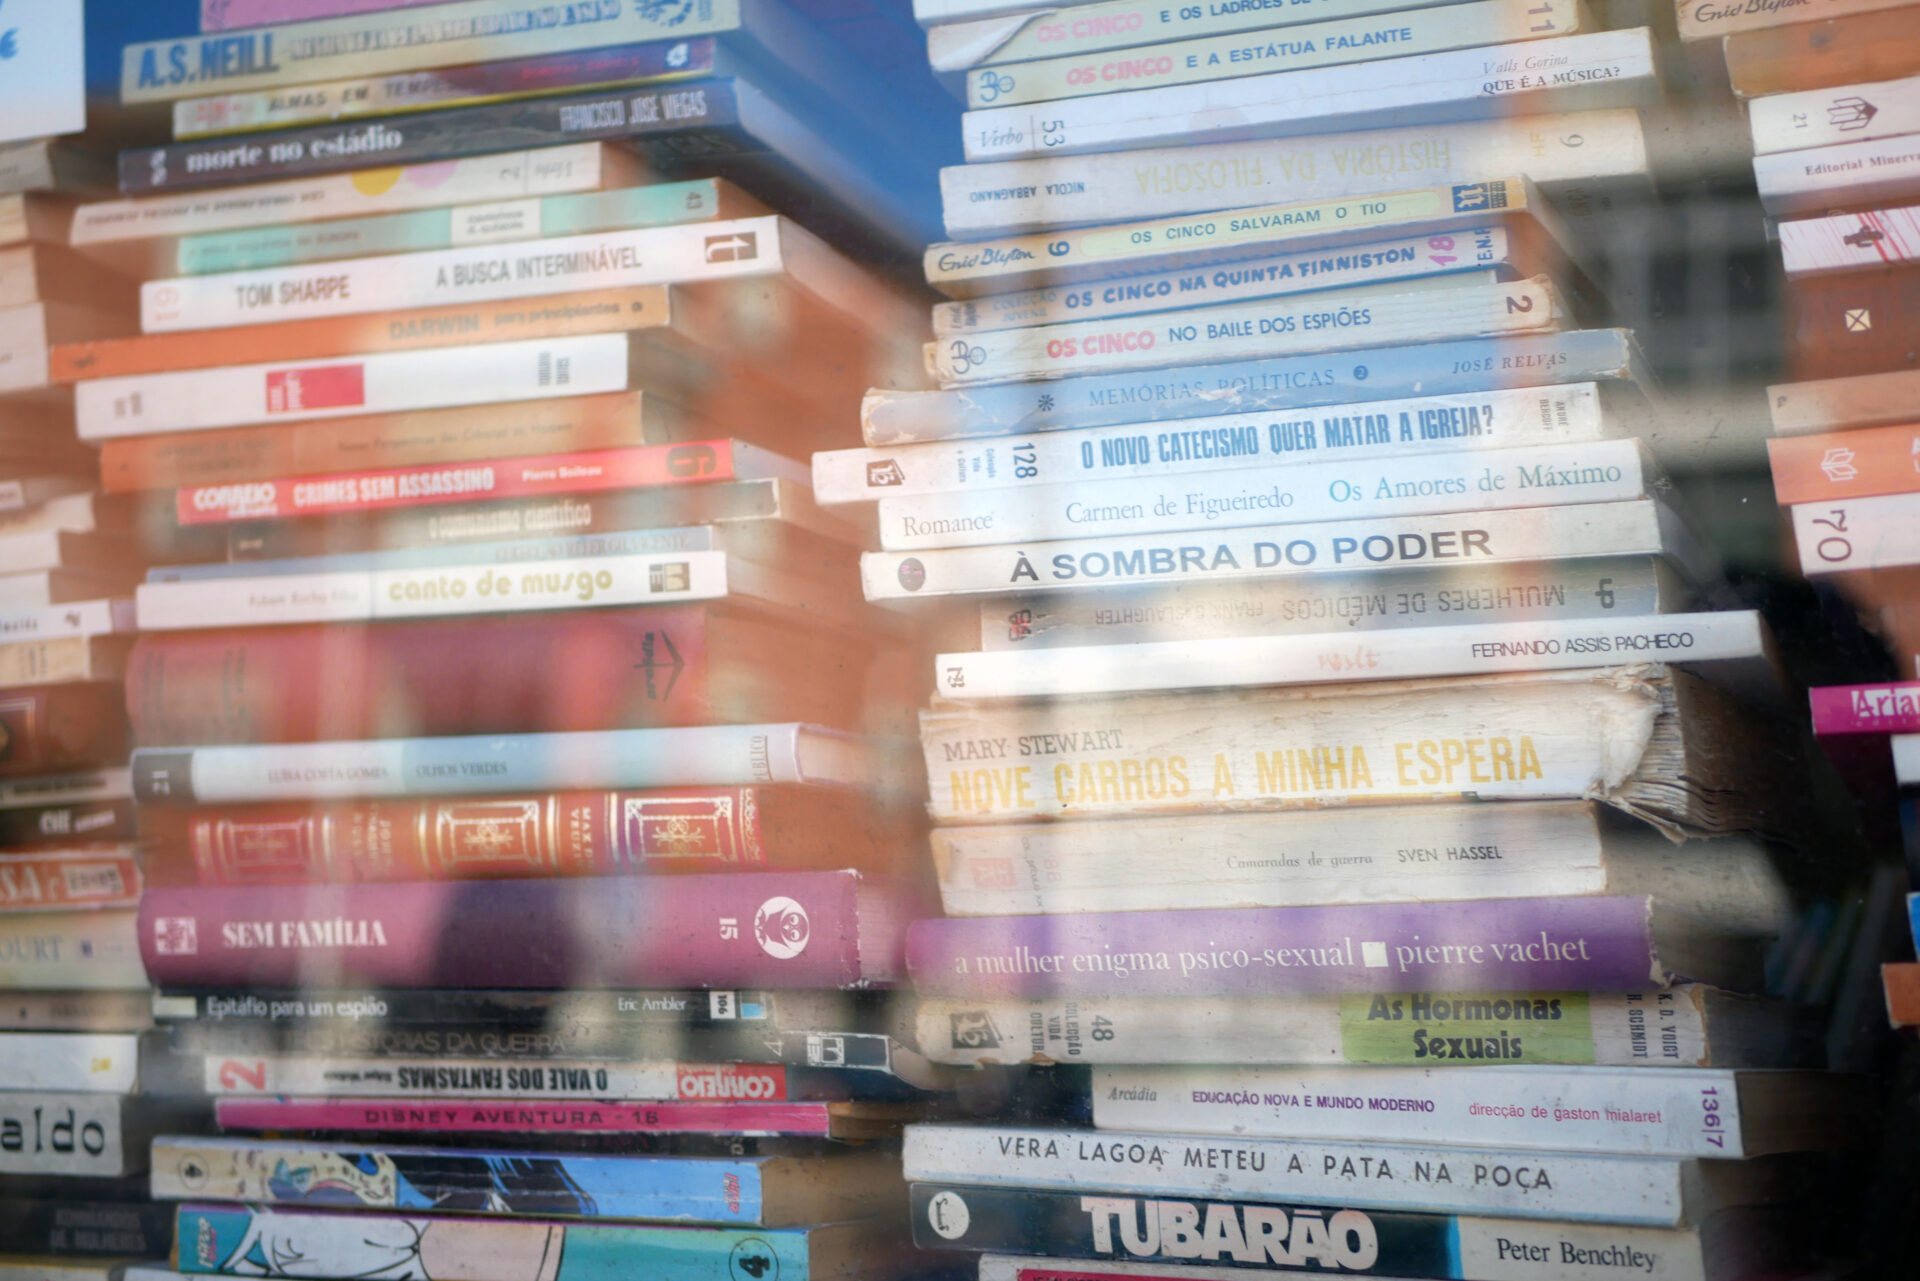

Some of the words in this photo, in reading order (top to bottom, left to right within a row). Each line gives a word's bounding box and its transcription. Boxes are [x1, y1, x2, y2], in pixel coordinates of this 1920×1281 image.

[1037, 24, 1067, 42] OS
[1071, 12, 1145, 40] CINCO
[1160, 10, 1171, 24] E
[1180, 5, 1202, 21] OS
[1694, 3, 1743, 22] Enid
[1066, 66, 1097, 86] OS
[1101, 55, 1173, 82] CINCO
[1186, 56, 1198, 69] E
[1207, 52, 1220, 66] A
[1229, 36, 1317, 63] ESTÁTUA
[1325, 27, 1413, 50] FALANTE
[1482, 58, 1518, 75] Valls
[1523, 53, 1569, 70] Gorina
[1482, 79, 1515, 96] QUE
[1520, 73, 1532, 89] É
[1535, 74, 1548, 87] A
[1552, 65, 1622, 85] MÚSICA?
[980, 127, 1025, 149] Verbo
[1042, 119, 1066, 148] 53
[186, 142, 263, 172] morte
[270, 140, 303, 162] no
[310, 124, 403, 158] estádio
[1331, 139, 1451, 177] HISTÓRIA
[1134, 158, 1263, 195] FILOSOFIA
[1280, 154, 1316, 182] DA
[1805, 158, 1864, 177] Editorial
[970, 186, 1037, 203] ABBAGNANO
[1047, 182, 1085, 197] NICOLA
[1131, 231, 1152, 245] OS
[1166, 224, 1217, 240] CINCO
[1230, 210, 1321, 232] SALVARAM
[1336, 207, 1348, 219] O
[1361, 202, 1387, 216] TIO
[436, 267, 447, 288] A
[454, 258, 511, 285] BUSCA
[516, 243, 642, 280] INTERMINÁVEL
[938, 249, 979, 271] Enid
[980, 246, 1036, 271] Blyton
[236, 284, 273, 309] TOM
[280, 275, 352, 304] SHARPE
[1065, 291, 1094, 309] OS
[1103, 281, 1172, 304] CINCO
[1179, 277, 1207, 291] NA
[1213, 263, 1295, 289] QUINTA
[1299, 247, 1416, 277] FINNISTON
[1506, 295, 1533, 313] 2
[389, 314, 479, 340] DARWIN
[1047, 339, 1078, 359] OS
[1082, 330, 1156, 355] CINCO
[1169, 326, 1198, 343] NO
[1206, 322, 1253, 341] BAILE
[1260, 317, 1295, 335] DOS
[1303, 307, 1371, 331] ESPIÕES
[1452, 356, 1493, 375] JOSÉ
[1218, 368, 1335, 395] POLÍTICAS
[1082, 440, 1093, 469] O
[1101, 435, 1151, 468] NOVO
[1158, 425, 1259, 464] CATECISMO
[1269, 421, 1317, 453] QUER
[1324, 414, 1391, 447] MATAR
[1400, 411, 1413, 441] A
[1419, 404, 1494, 441] IGREJA?
[1012, 441, 1038, 480] 128
[293, 478, 357, 508] CRIMES
[359, 473, 395, 501] SEM
[399, 465, 494, 498] ASSASSINO
[1065, 498, 1144, 525] Carmen
[1153, 493, 1178, 518] de
[1185, 486, 1295, 521] Figueiredo
[1329, 479, 1363, 503] Os
[1374, 475, 1467, 500] Amores
[1479, 468, 1505, 492] de
[1516, 464, 1623, 490] Máximo
[903, 514, 994, 538] Romance
[1812, 509, 1852, 562] 70
[1009, 550, 1040, 583] À
[1052, 543, 1239, 580] SOMBRA
[1254, 539, 1317, 568] DO
[1333, 528, 1494, 563] PODER
[389, 571, 468, 601] canto
[476, 570, 513, 597] de
[1437, 584, 1565, 612] MULHERES
[1095, 607, 1185, 625] SLAUGHTER
[1398, 591, 1426, 613] DE
[1471, 639, 1561, 658] FERNANDO
[1565, 636, 1612, 654] ASSIS
[1615, 631, 1694, 651] PACHECO
[944, 739, 1007, 763] MARY
[1018, 728, 1124, 756] STEWART
[951, 766, 1036, 811] NOVE
[1054, 756, 1191, 807] CARROS
[1213, 753, 1234, 796] A
[1255, 745, 1373, 793] MINHA
[1395, 736, 1543, 787] ESPERA
[1226, 854, 1300, 869] Camaradas
[1307, 854, 1324, 867] de
[1397, 847, 1439, 864] SVEN
[1447, 845, 1503, 861] HASSEL
[223, 921, 275, 950] SEM
[281, 916, 387, 948] FAMÍLIA
[718, 917, 739, 940] 15
[956, 955, 969, 975] a
[976, 946, 1064, 974] mulher
[1072, 943, 1171, 979] enigma
[1179, 936, 1355, 978] psico-sexual
[1396, 935, 1485, 972] pierre
[1491, 931, 1592, 962] vachet
[207, 995, 269, 1020] Epitáfio
[271, 1001, 306, 1019] para
[309, 1003, 333, 1017] um
[337, 998, 389, 1020] espião
[617, 996, 640, 1013] Eric
[642, 996, 686, 1013] Ambler
[1367, 996, 1404, 1021] As
[1410, 993, 1563, 1021] Hormonas
[1091, 1015, 1115, 1042] 48
[1413, 1029, 1523, 1059] Sexuais
[397, 1065, 501, 1090] FANTASMAS
[507, 1066, 545, 1090] DOS
[549, 1066, 592, 1090] VALE
[595, 1067, 609, 1090] O
[681, 1071, 776, 1099] CORREIO
[1108, 1085, 1158, 1103] Arcádia
[1192, 1088, 1261, 1108] EDUCAÇÃO
[1264, 1093, 1300, 1108] NOVA
[1304, 1094, 1313, 1108] E
[1316, 1093, 1365, 1110] MUNDO
[1368, 1097, 1436, 1113] MODERNO
[364, 1110, 458, 1125] DISNEY
[472, 1110, 603, 1126] AVENTURA
[1468, 1101, 1526, 1119] direcção
[1530, 1103, 1549, 1119] de
[1553, 1105, 1600, 1125] gaston
[1604, 1107, 1663, 1124] mialaret
[998, 1136, 1060, 1160] VERA
[1079, 1141, 1166, 1166] LAGOA
[1184, 1147, 1267, 1172] METEU
[1287, 1155, 1303, 1175] A
[1323, 1156, 1395, 1180] PATA
[1414, 1161, 1454, 1184] NA
[1475, 1165, 1553, 1195] POÇA
[1080, 1195, 1379, 1271] TUBARÃO
[1497, 1238, 1551, 1265] Peter
[1560, 1242, 1657, 1273] Benchley
